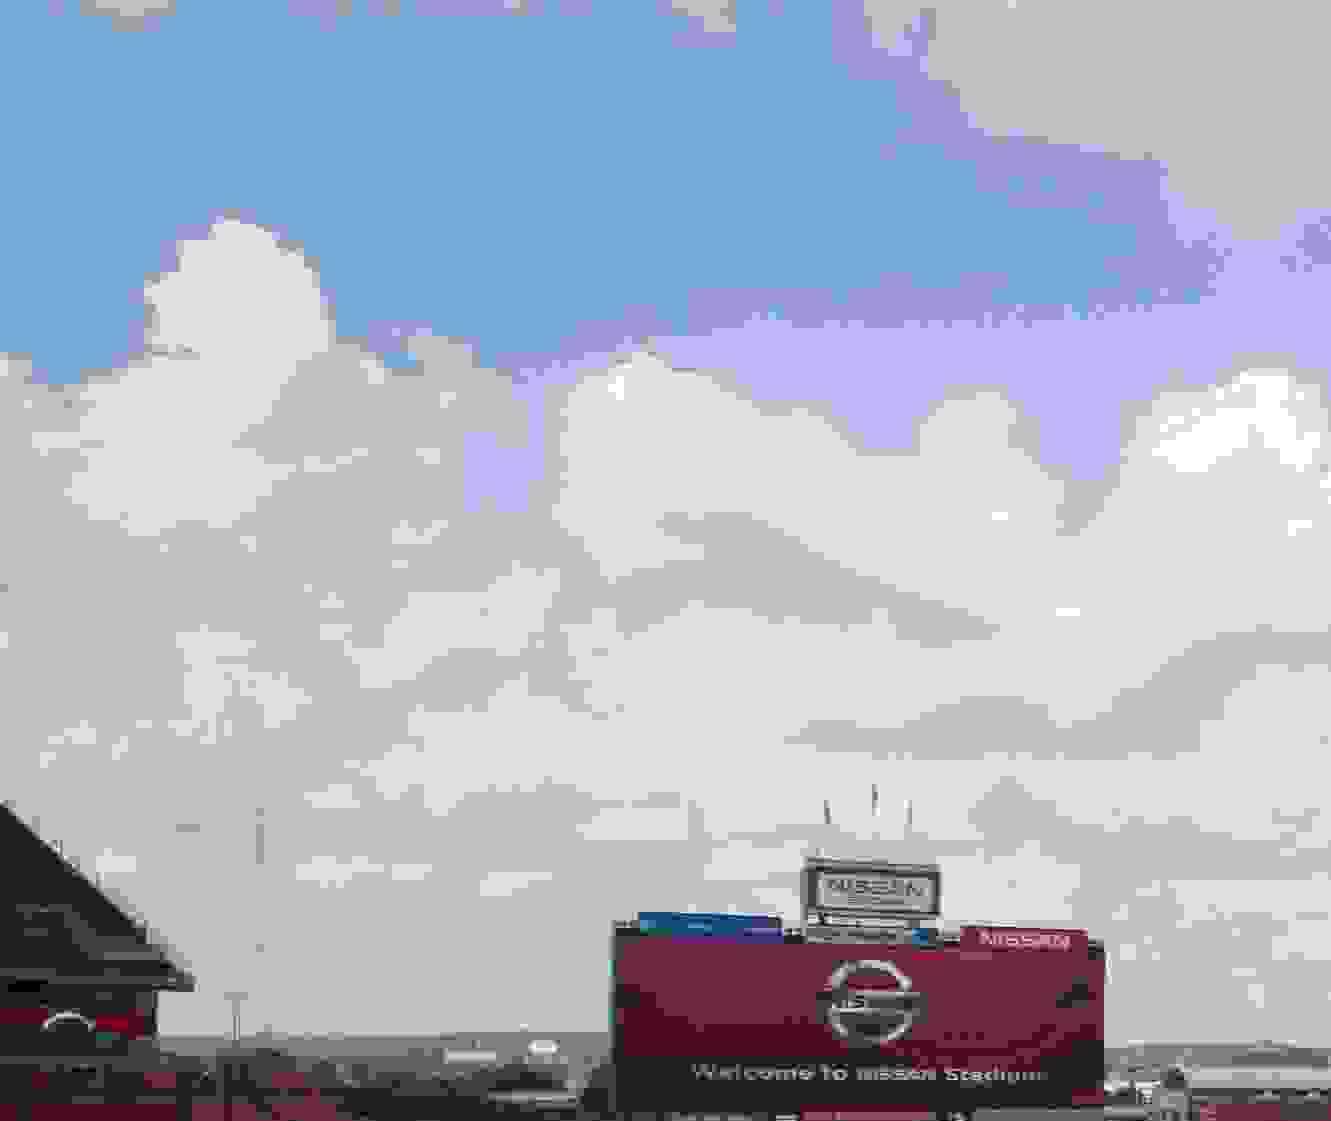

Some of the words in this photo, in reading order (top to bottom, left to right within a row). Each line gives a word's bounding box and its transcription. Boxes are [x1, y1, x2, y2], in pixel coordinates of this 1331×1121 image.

[828, 879, 926, 897] NISSAN
[978, 929, 1073, 951] NISSAN
[689, 1063, 815, 1081] Welcome
[818, 1063, 849, 1081] to
[942, 1064, 1047, 1082] Stadium
